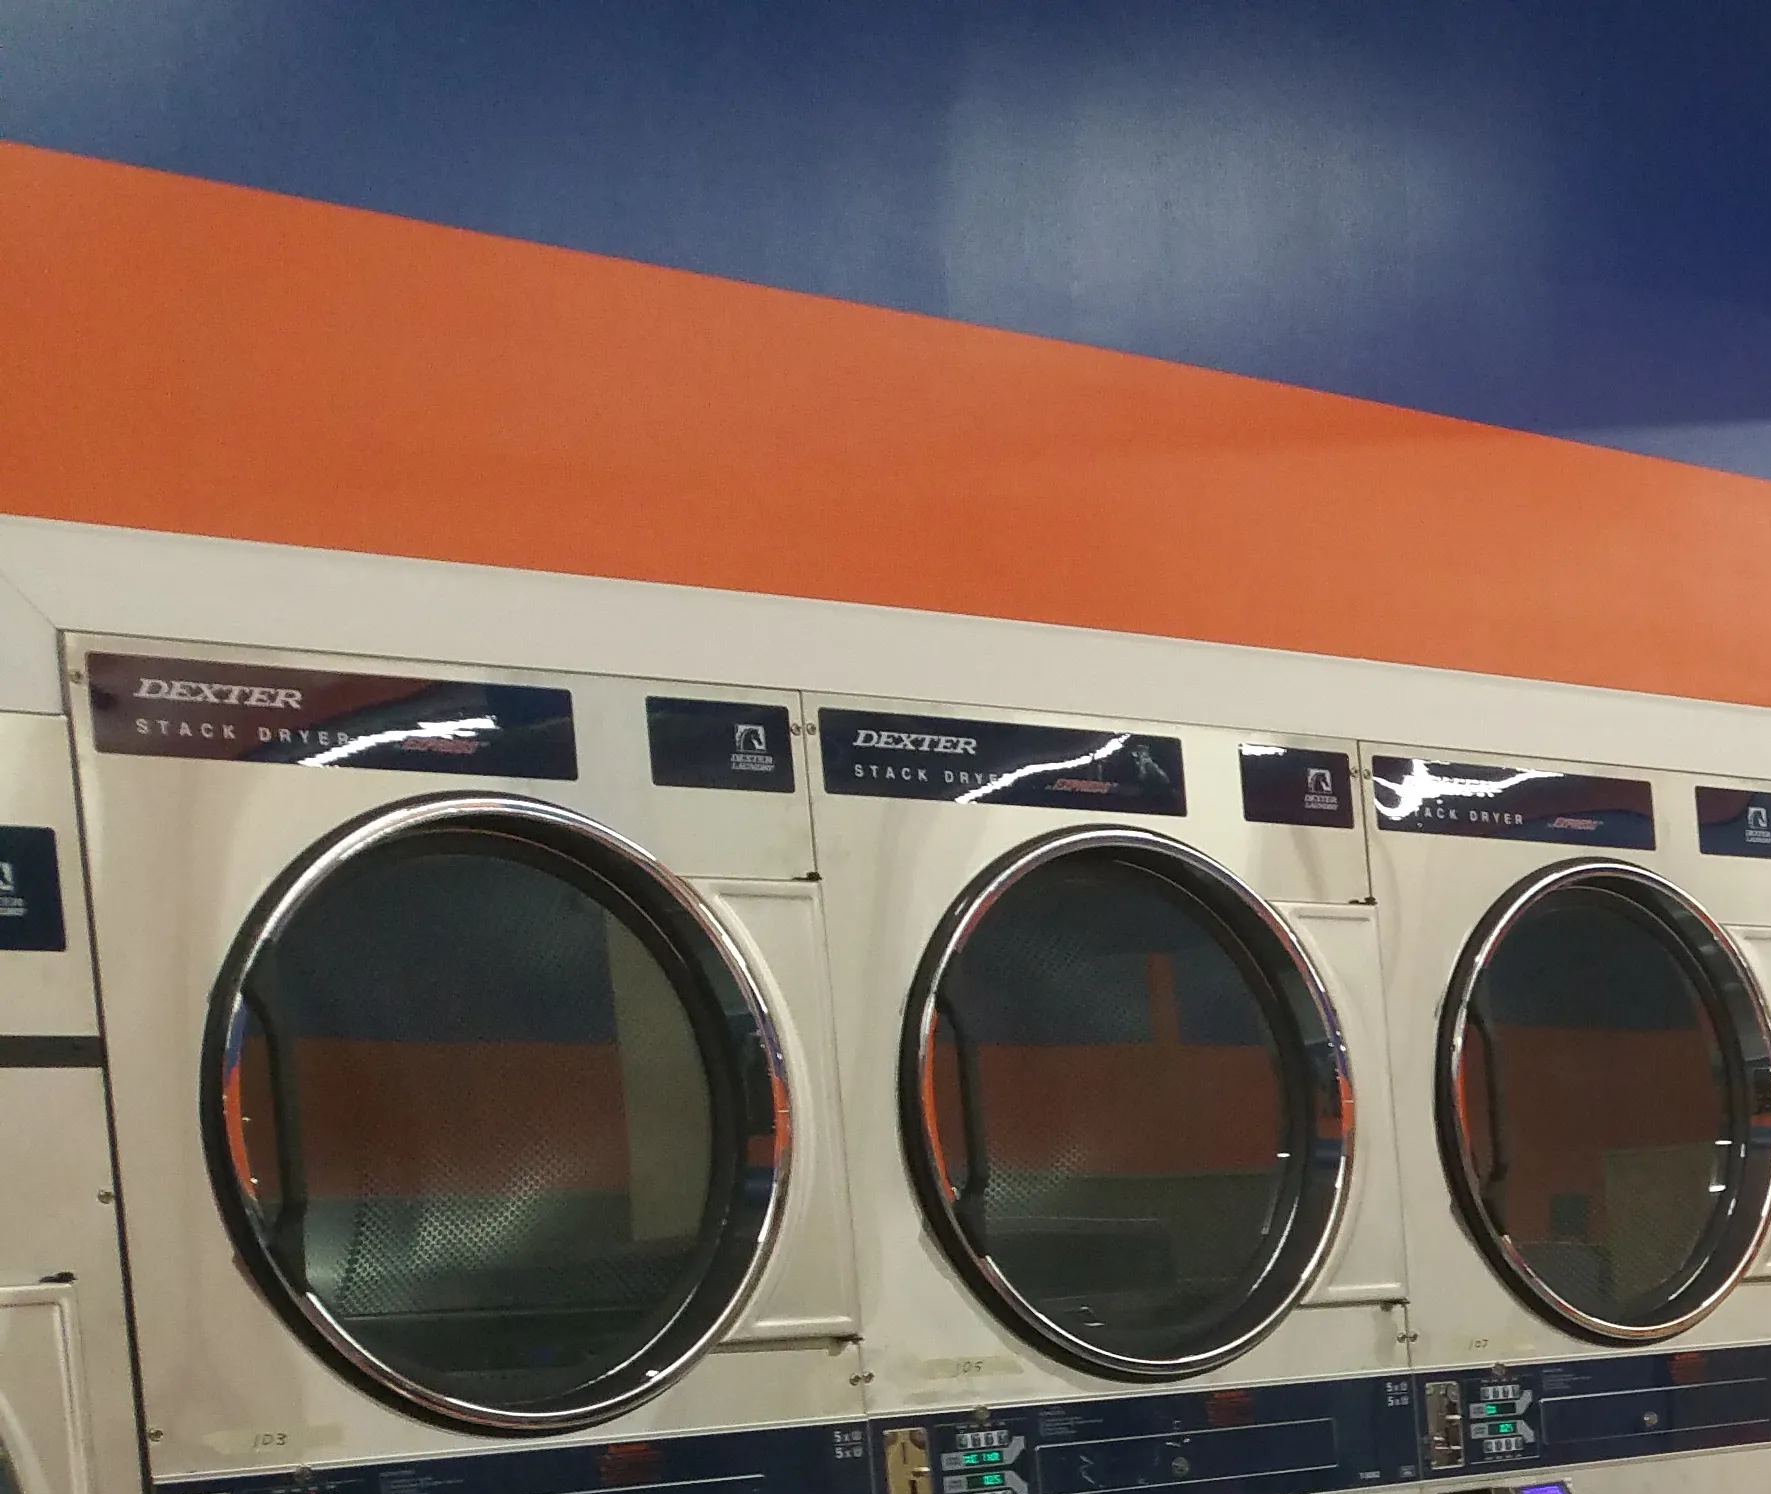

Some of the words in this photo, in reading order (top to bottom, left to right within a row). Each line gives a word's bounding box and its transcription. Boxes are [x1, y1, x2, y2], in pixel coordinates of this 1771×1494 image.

[133, 677, 303, 709] DEXTER
[135, 717, 236, 740] STACK
[257, 726, 351, 747] DRYER
[852, 729, 977, 755] DEXTER
[854, 763, 929, 782] STACK
[943, 770, 1002, 787] DRYE
[1469, 810, 1524, 826] DRYER
